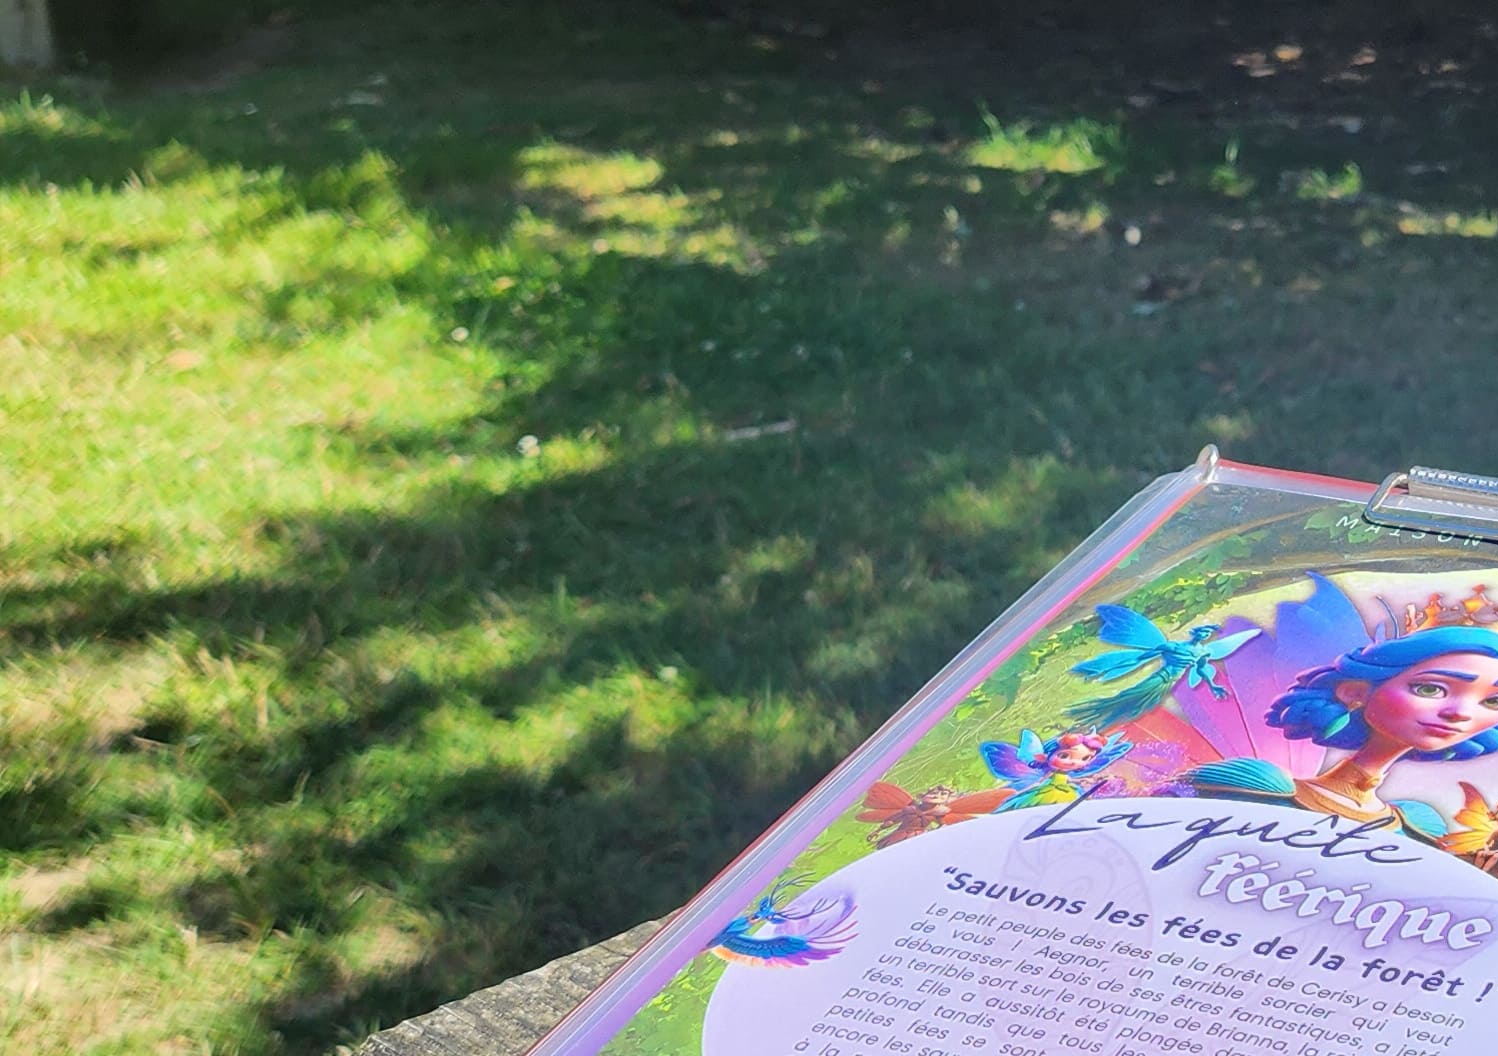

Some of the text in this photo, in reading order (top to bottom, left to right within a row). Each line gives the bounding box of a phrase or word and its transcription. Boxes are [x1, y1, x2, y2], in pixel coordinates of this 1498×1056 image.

[1023, 779, 1422, 871] La quête
[1198, 852, 1493, 950] féérique
[893, 934, 1014, 969] débarrasser
[1012, 958, 1045, 976] les
[1046, 965, 1092, 987] bois
[1095, 976, 1125, 993] de
[1128, 986, 1166, 1003] ses
[1169, 992, 1224, 1016] êtres
[1227, 1005, 1364, 1051] fantastiques,
[1373, 1041, 1392, 1055] a
[909, 918, 1454, 1048] de vous ! Aegnor, un terrible sorcier qui veut
[924, 901, 1466, 1030] Le petit peuple des fées de la forêt de Cerisy a besoin
[1094, 901, 1150, 928] les
[1162, 915, 1242, 947] fées
[1253, 936, 1298, 960] de
[1308, 946, 1346, 971] la
[1361, 958, 1465, 997] forêt
[793, 1036, 811, 1052] à
[810, 1021, 880, 1046] encore
[881, 1034, 914, 1054] les
[822, 1004, 896, 1028] petites
[905, 1018, 951, 1040] fées
[960, 1034, 987, 1049] se
[840, 986, 927, 1013] profond
[932, 1004, 996, 1029] tandis
[1006, 1022, 1047, 1040] que
[1057, 1032, 1104, 1054] tous
[860, 966, 904, 989] fées.
[915, 977, 952, 998] Elle
[959, 991, 977, 1003] a
[984, 996, 1066, 1024] aussitôt
[1073, 1013, 1111, 1033] été
[1113, 1025, 1204, 1055] plongée
[877, 952, 904, 967] un
[906, 957, 976, 982] terrible
[976, 974, 1019, 992] sort
[1019, 983, 1056, 999] sur
[1054, 986, 1076, 1004] le
[1077, 996, 1170, 1025] royaume
[1172, 1015, 1202, 1032] de
[1204, 1021, 1290, 1055] Brianna,
